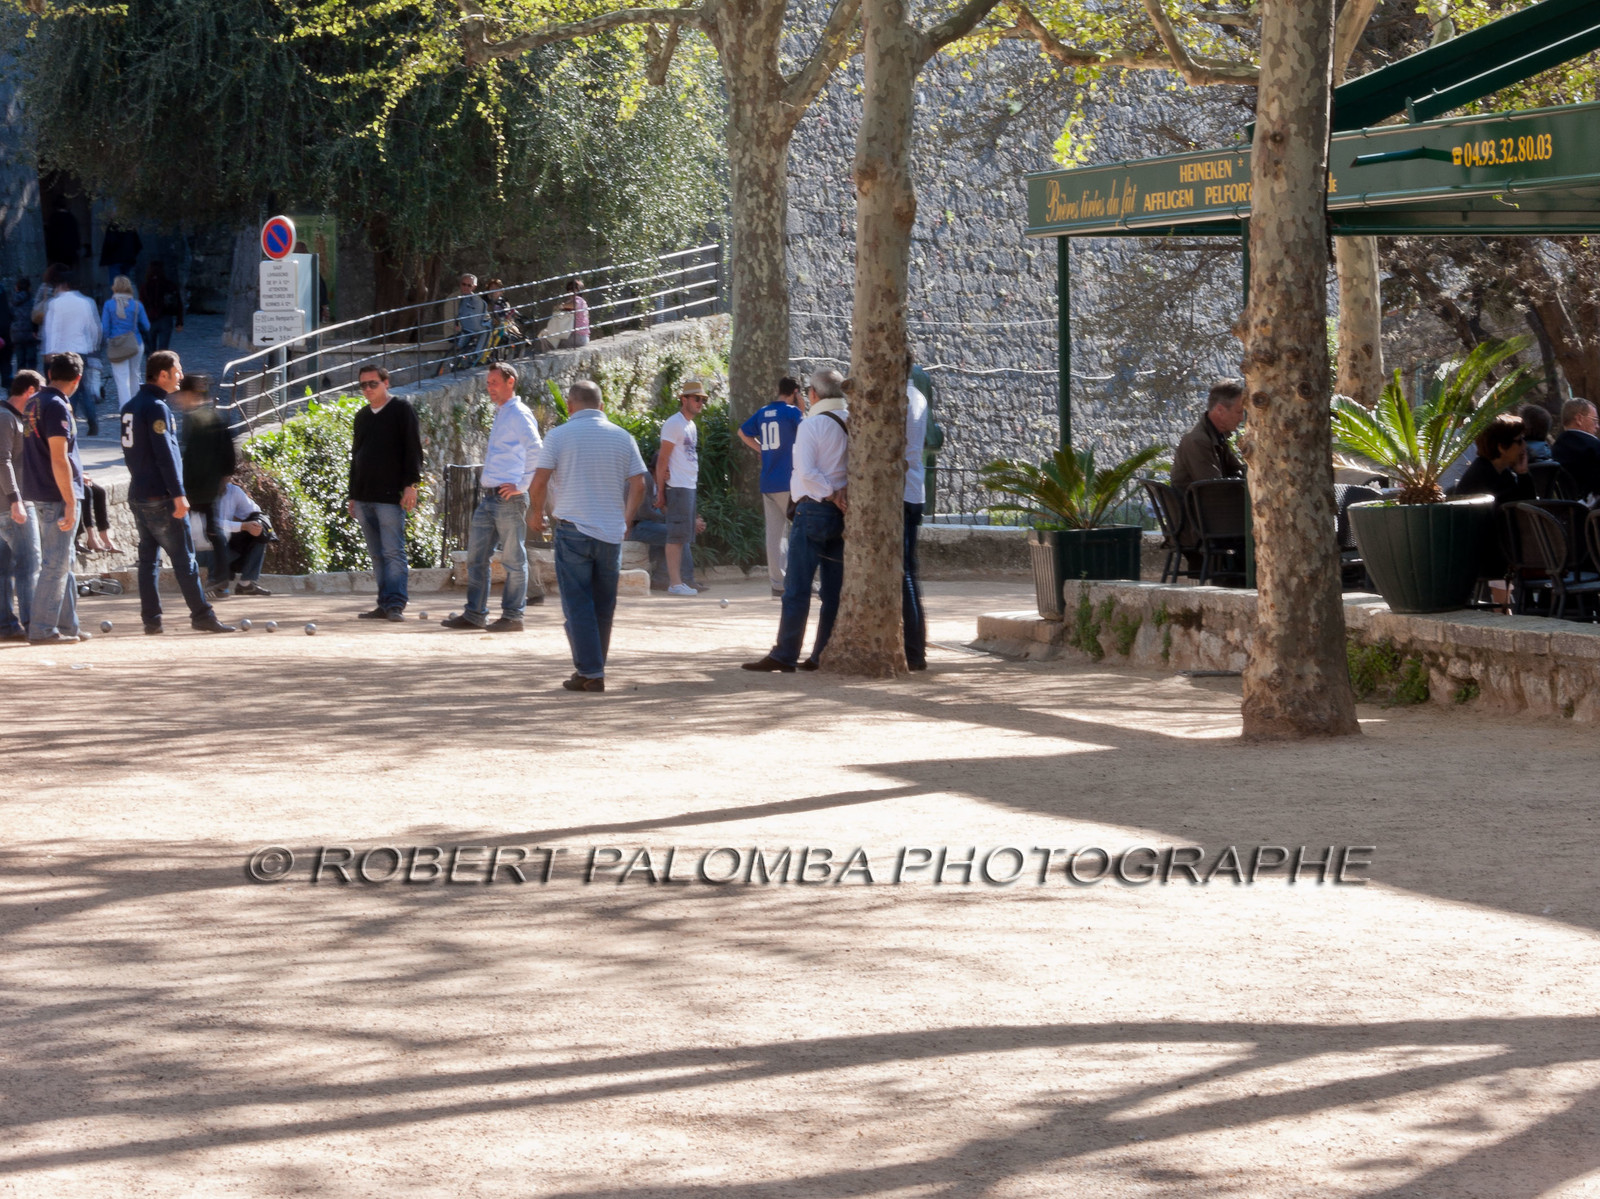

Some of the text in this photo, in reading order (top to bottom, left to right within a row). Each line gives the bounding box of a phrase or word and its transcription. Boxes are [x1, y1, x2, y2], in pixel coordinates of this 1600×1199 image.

[1463, 133, 1552, 168] 04.93.32.80.03
[1179, 159, 1232, 183] HEINEKEN
[1106, 178, 1119, 216] du
[1143, 188, 1193, 212] AFFLIGEM
[1205, 181, 1252, 205] PELFORT
[121, 413, 134, 448] 3
[760, 421, 780, 451] 10
